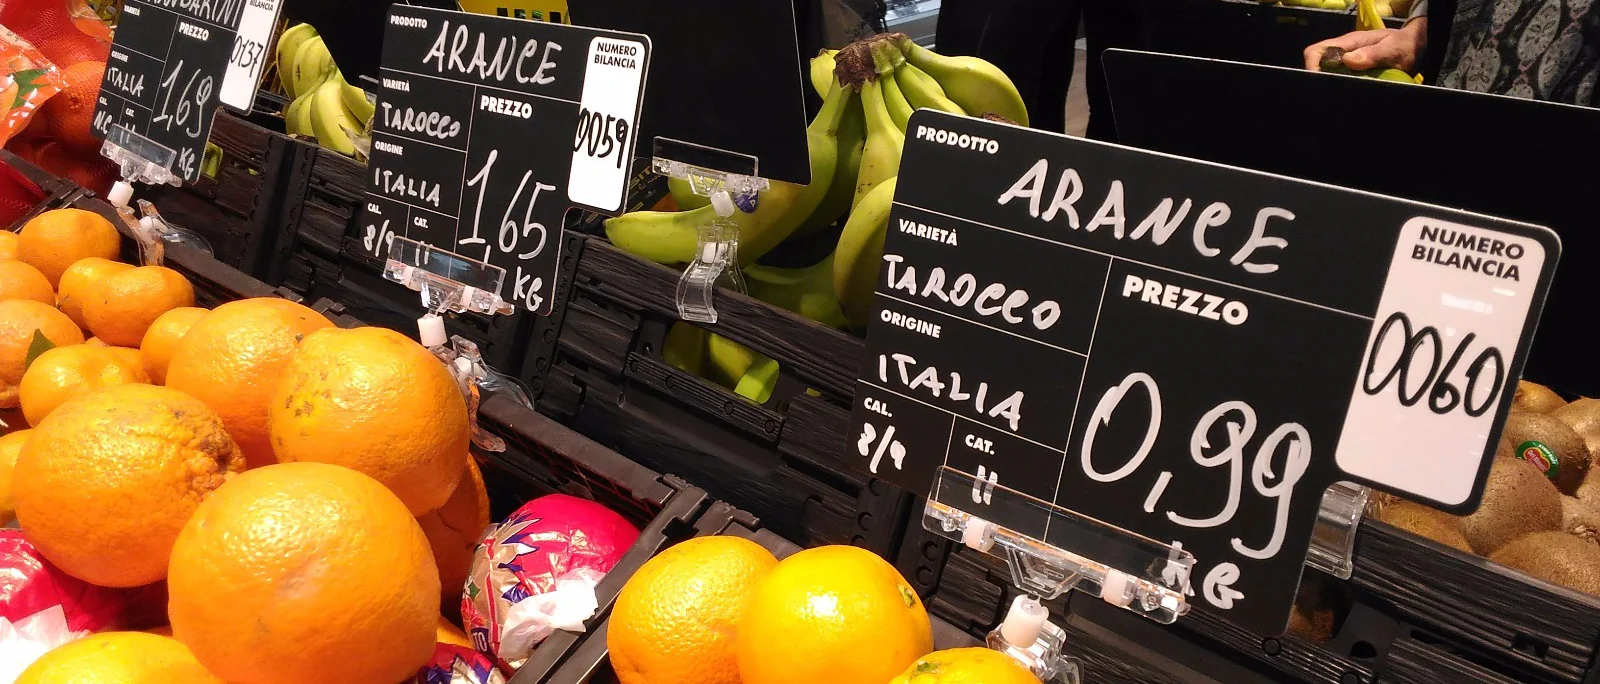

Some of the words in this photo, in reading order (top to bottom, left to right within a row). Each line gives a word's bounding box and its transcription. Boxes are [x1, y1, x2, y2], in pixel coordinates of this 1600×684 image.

[179, 22, 209, 41] PREZZO
[390, 14, 428, 29] PRODOTTO
[230, 35, 264, 78] 0137
[422, 20, 562, 85] ARANCE
[594, 54, 636, 69] BILANCIA
[596, 41, 637, 56] NUMERO
[107, 67, 144, 97] ITALIA
[382, 77, 411, 92] VARIETÀ
[381, 101, 461, 140] TAROCCO
[480, 95, 532, 119] PREZZO
[374, 140, 404, 155] ORIGINE
[574, 107, 629, 169] 0059
[916, 125, 1000, 155] PRODOTTO
[374, 167, 440, 207] ITALIA
[367, 202, 382, 215] CAL.
[414, 216, 429, 229] CAT.
[458, 149, 556, 271] 1,65
[997, 158, 1296, 274] ARANCE
[363, 219, 395, 257] 8/9
[898, 218, 958, 247] VARIETÀ
[1418, 224, 1524, 260] NUMERO
[1411, 244, 1521, 282] BILANCIA
[512, 266, 544, 311] KG
[883, 254, 1061, 330] TAROCCO
[1122, 274, 1249, 326] PREZZO
[880, 308, 942, 339] ORIGINE
[1363, 311, 1505, 418] 0060
[863, 397, 893, 418] CAL.
[879, 353, 1025, 431] ITALIA
[964, 434, 995, 455] CAT.
[1081, 372, 1312, 560] 0,99
[1162, 540, 1245, 610] KG
